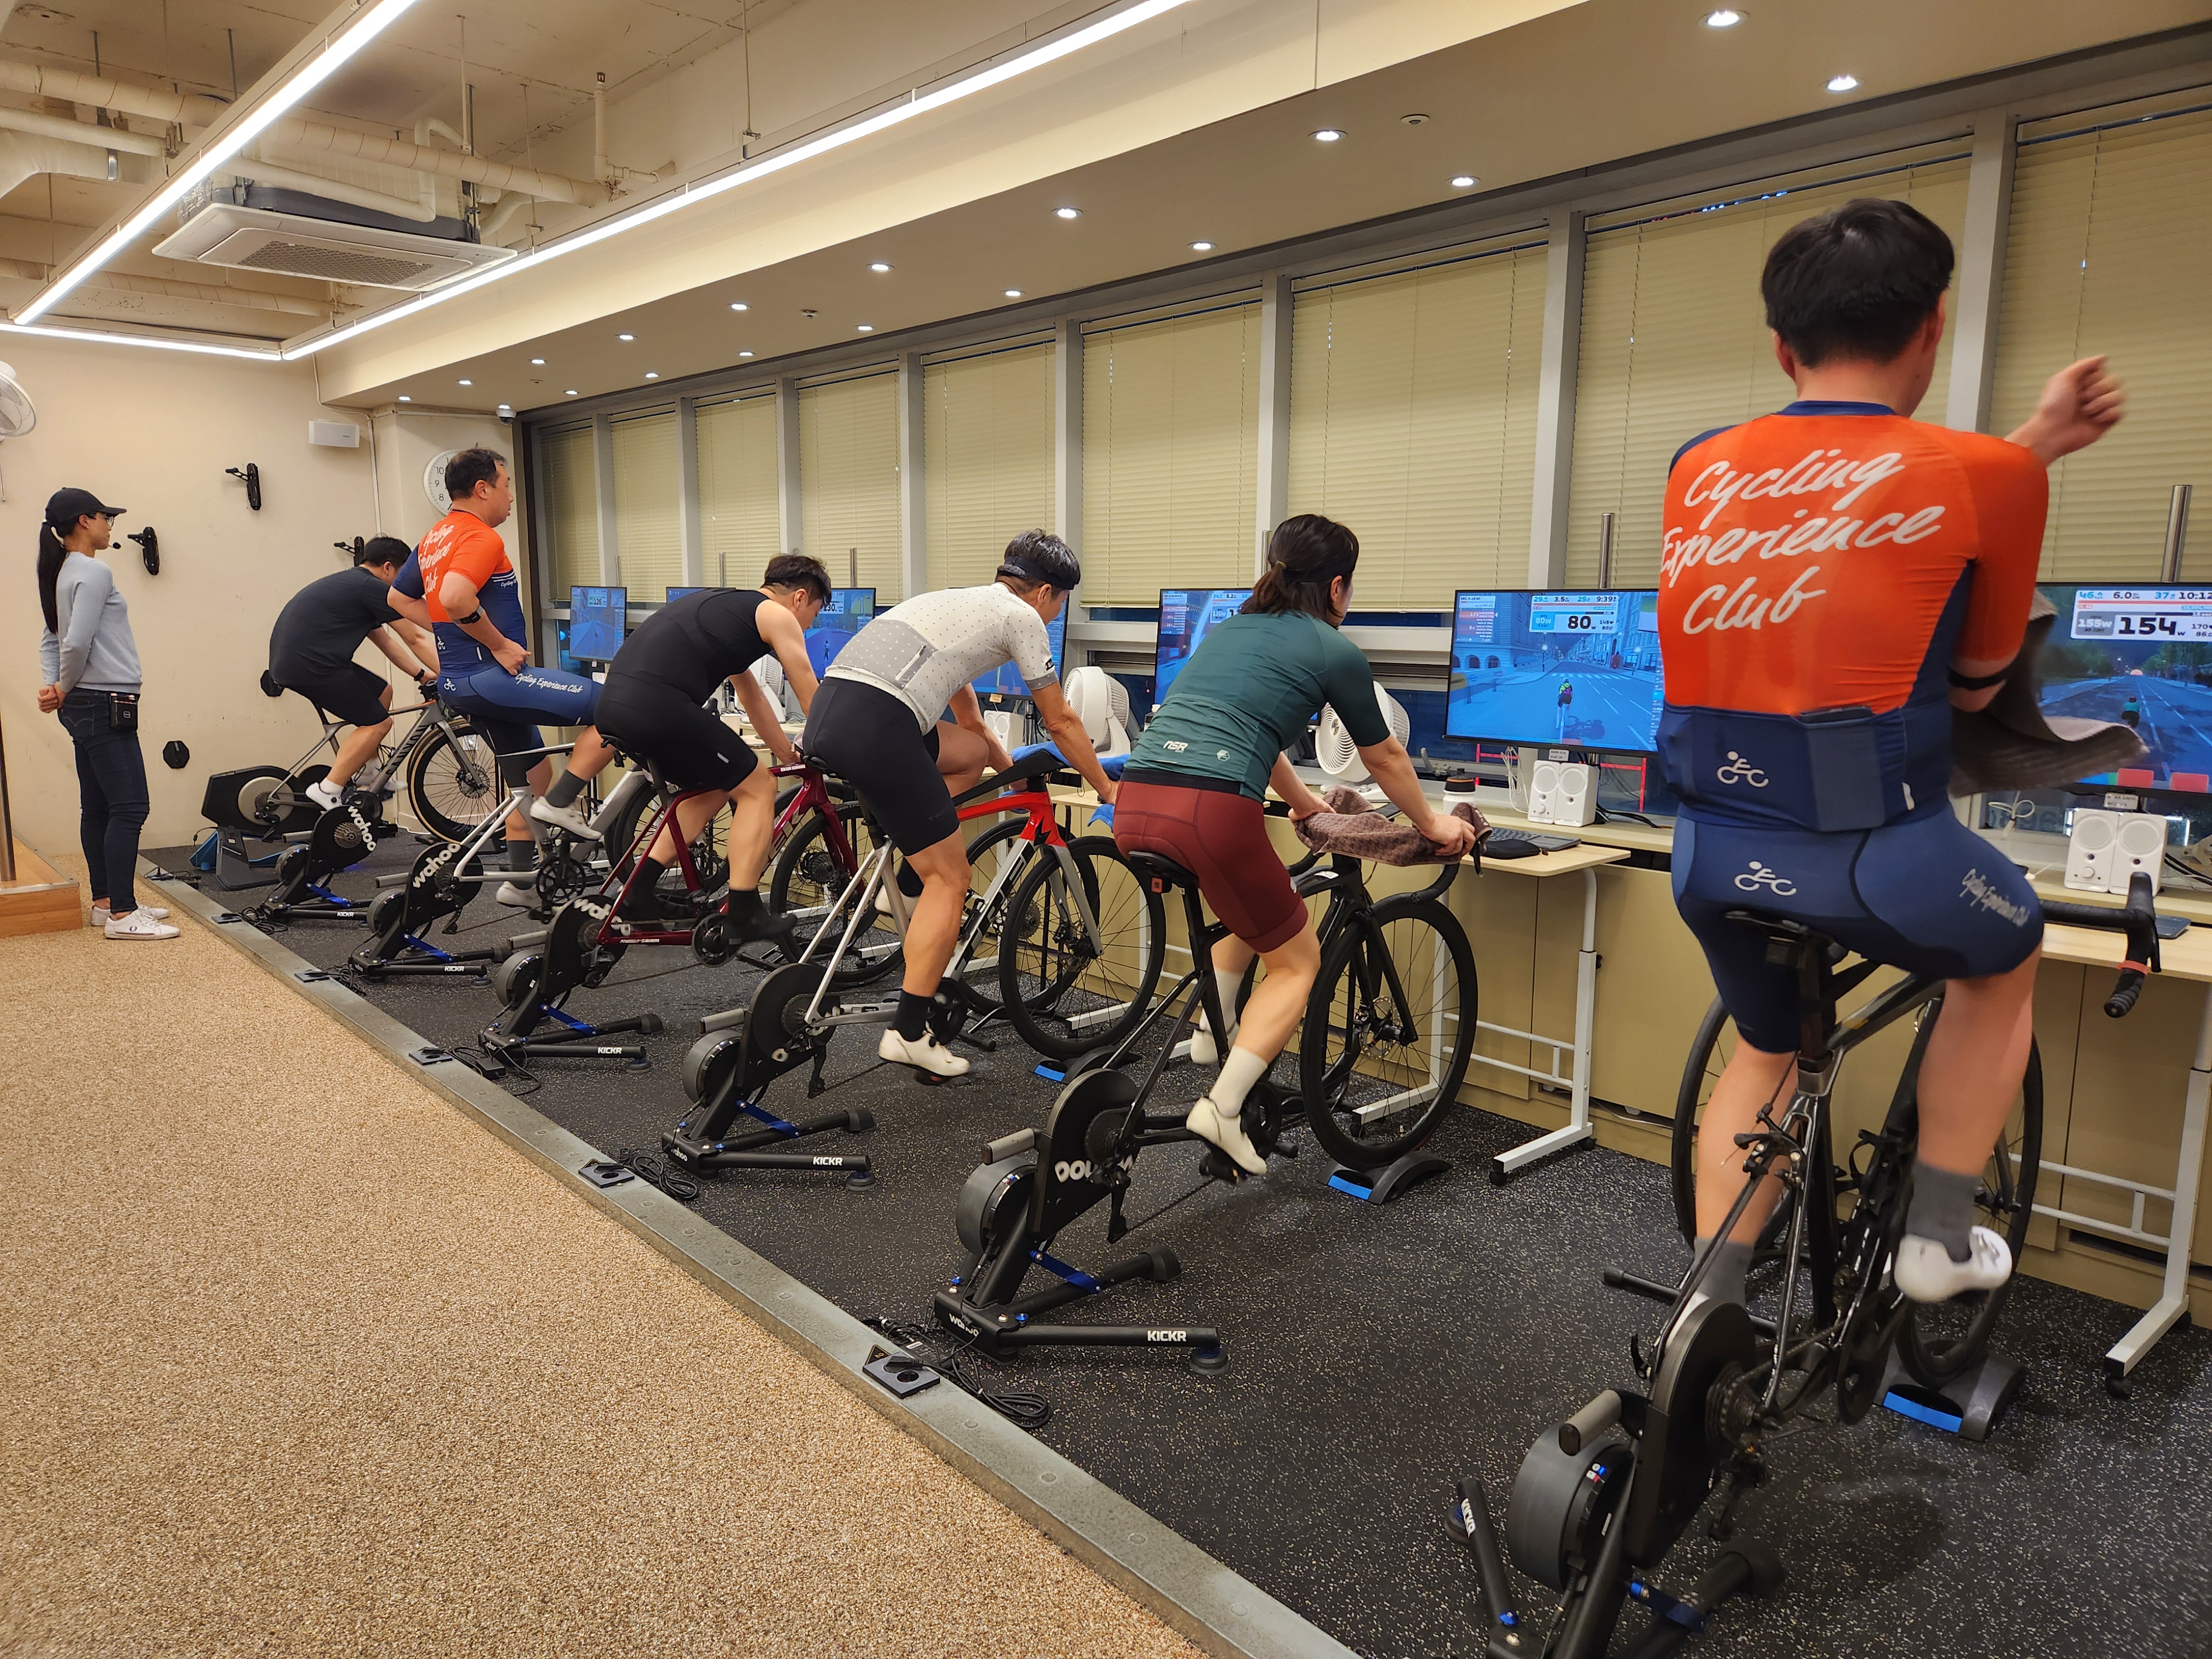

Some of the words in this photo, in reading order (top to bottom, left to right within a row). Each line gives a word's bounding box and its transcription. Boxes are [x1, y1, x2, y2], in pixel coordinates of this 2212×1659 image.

[1684, 449, 1906, 530] Cycling
[1660, 505, 1945, 588] Experience
[1683, 566, 1826, 634] Club
[1568, 615, 1591, 629] 80
[2078, 619, 2112, 628] 155w
[2119, 617, 2177, 635] 154
[515, 674, 537, 687] Cycling
[537, 678, 567, 689] Experience
[567, 685, 583, 693] Club
[348, 806, 377, 851] wahoo
[413, 843, 461, 888] wahoo
[813, 1156, 843, 1166] KICKR
[1147, 1330, 1187, 1342] KICKR
[1460, 1498, 1476, 1538] KICKR
